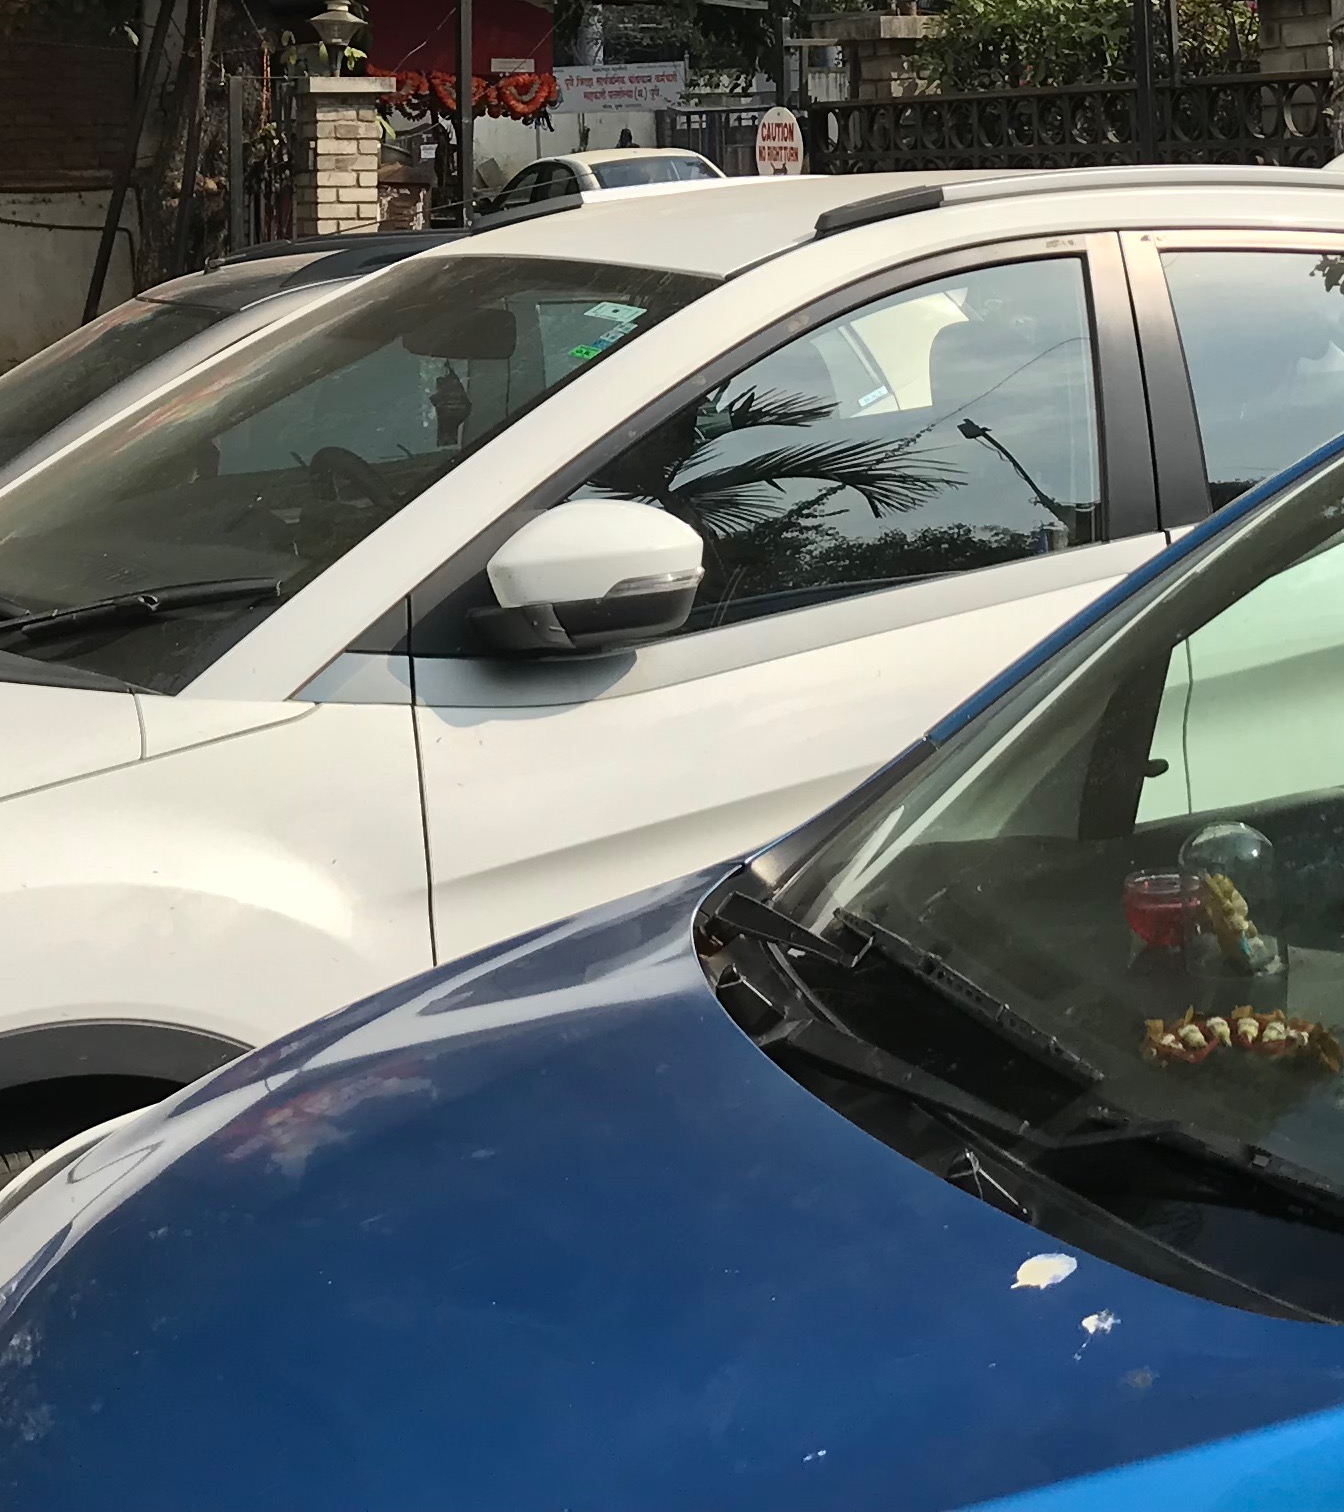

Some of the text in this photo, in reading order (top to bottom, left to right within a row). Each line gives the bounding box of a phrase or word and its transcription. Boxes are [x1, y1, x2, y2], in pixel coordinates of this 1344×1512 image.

[762, 122, 794, 142] CAUTION
[759, 146, 798, 162] NO RIGHT TURN
